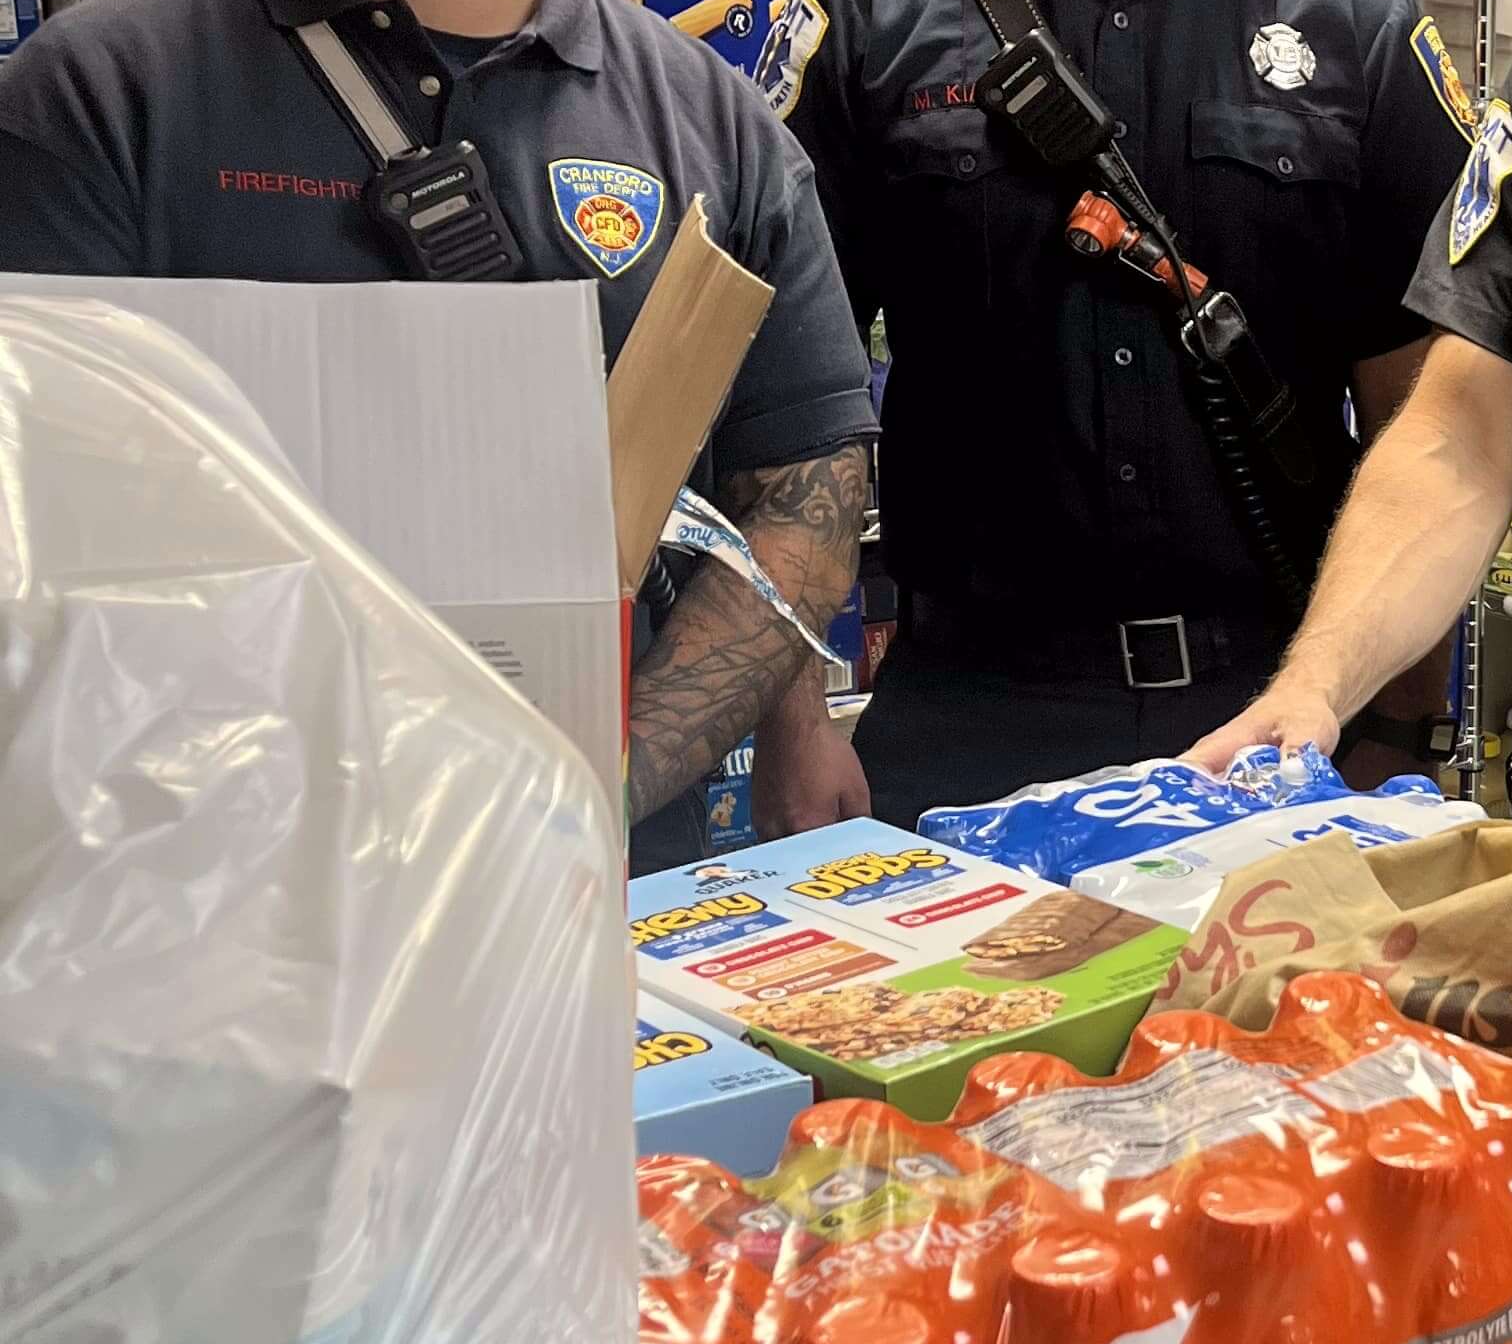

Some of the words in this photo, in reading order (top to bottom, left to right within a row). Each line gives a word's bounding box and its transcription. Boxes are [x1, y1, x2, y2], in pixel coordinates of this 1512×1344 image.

[412, 171, 466, 198] MOTOROLA
[559, 166, 653, 196] CRANFORD
[573, 182, 599, 195] FIRE
[603, 182, 638, 198] DEPT
[595, 218, 623, 233] CFD
[695, 869, 780, 895] QUAKER
